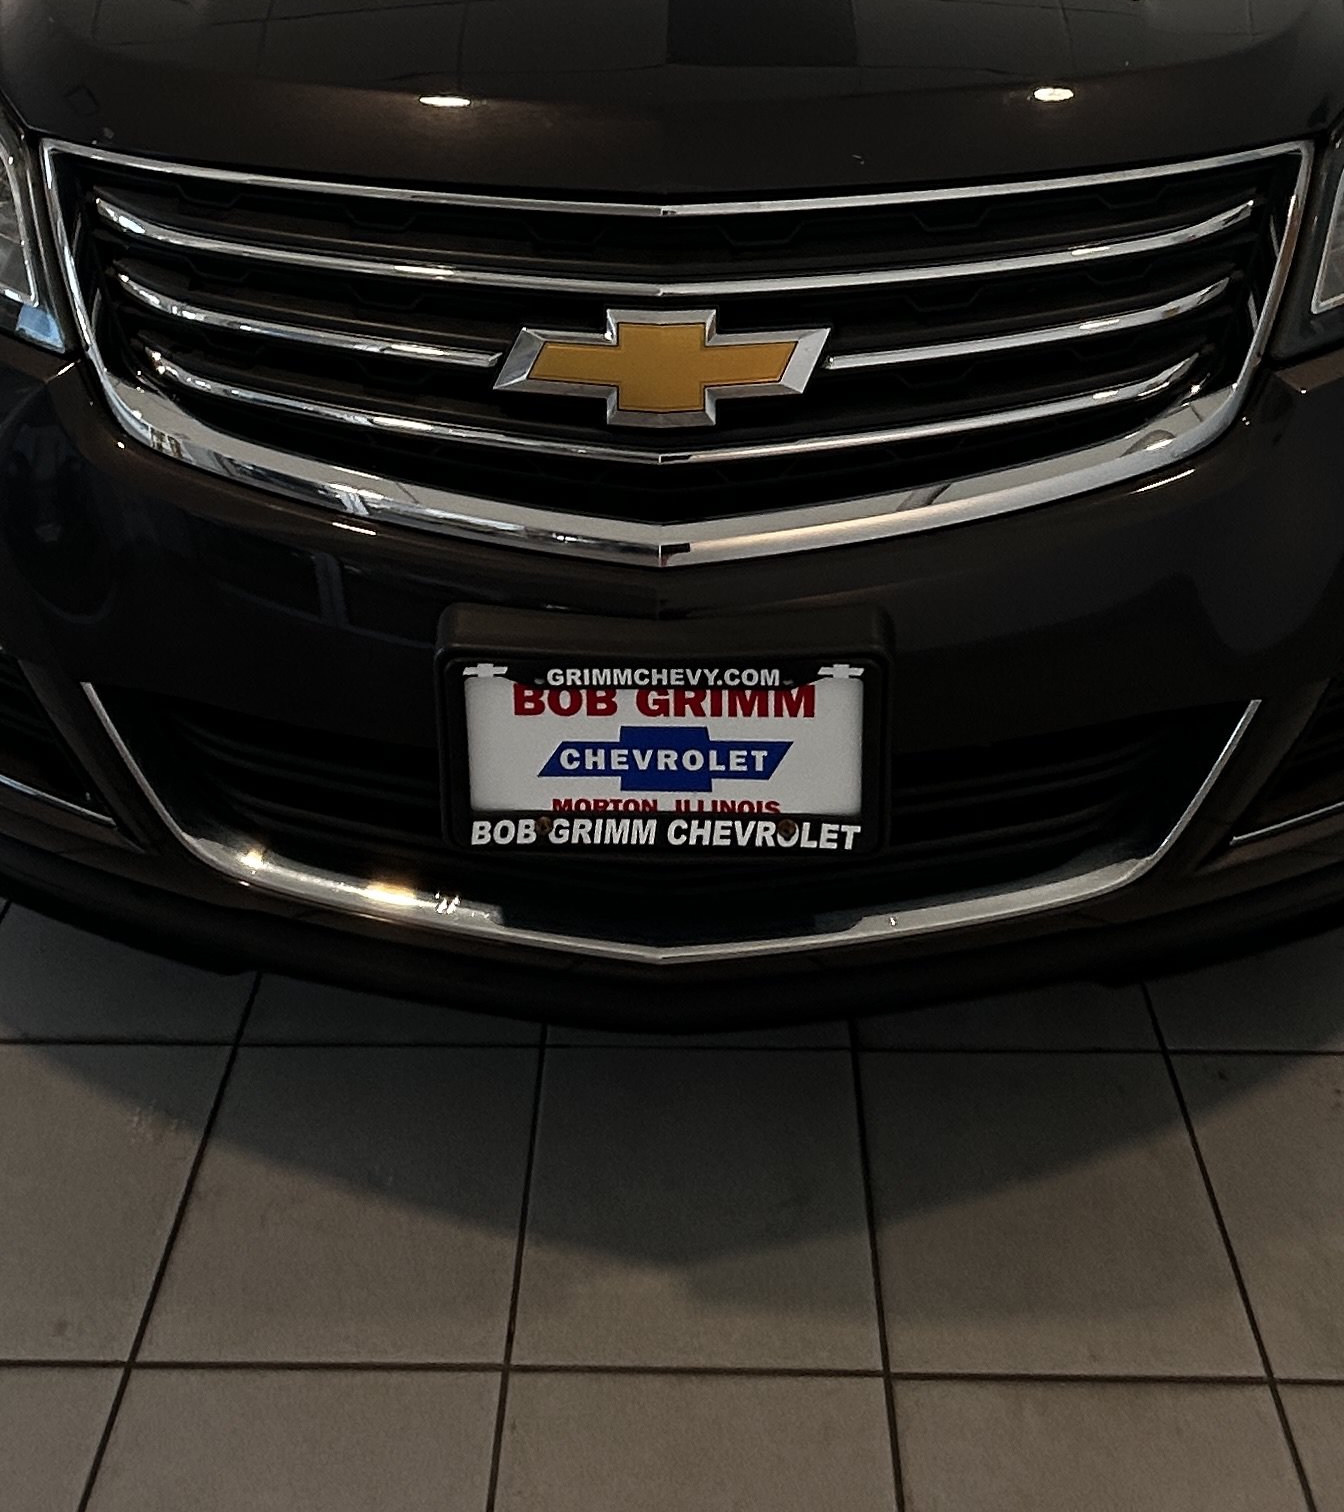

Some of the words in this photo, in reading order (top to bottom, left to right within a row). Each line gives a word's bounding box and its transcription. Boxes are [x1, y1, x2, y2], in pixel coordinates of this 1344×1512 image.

[547, 668, 780, 686] GRIMMCHEVY.COM
[513, 683, 618, 717] BOB
[636, 684, 815, 718] GRIMM
[559, 748, 768, 772] CHEVROLET
[471, 820, 538, 845] BOB
[549, 819, 657, 846] GRIMM
[667, 819, 861, 850] CHEVROLET
